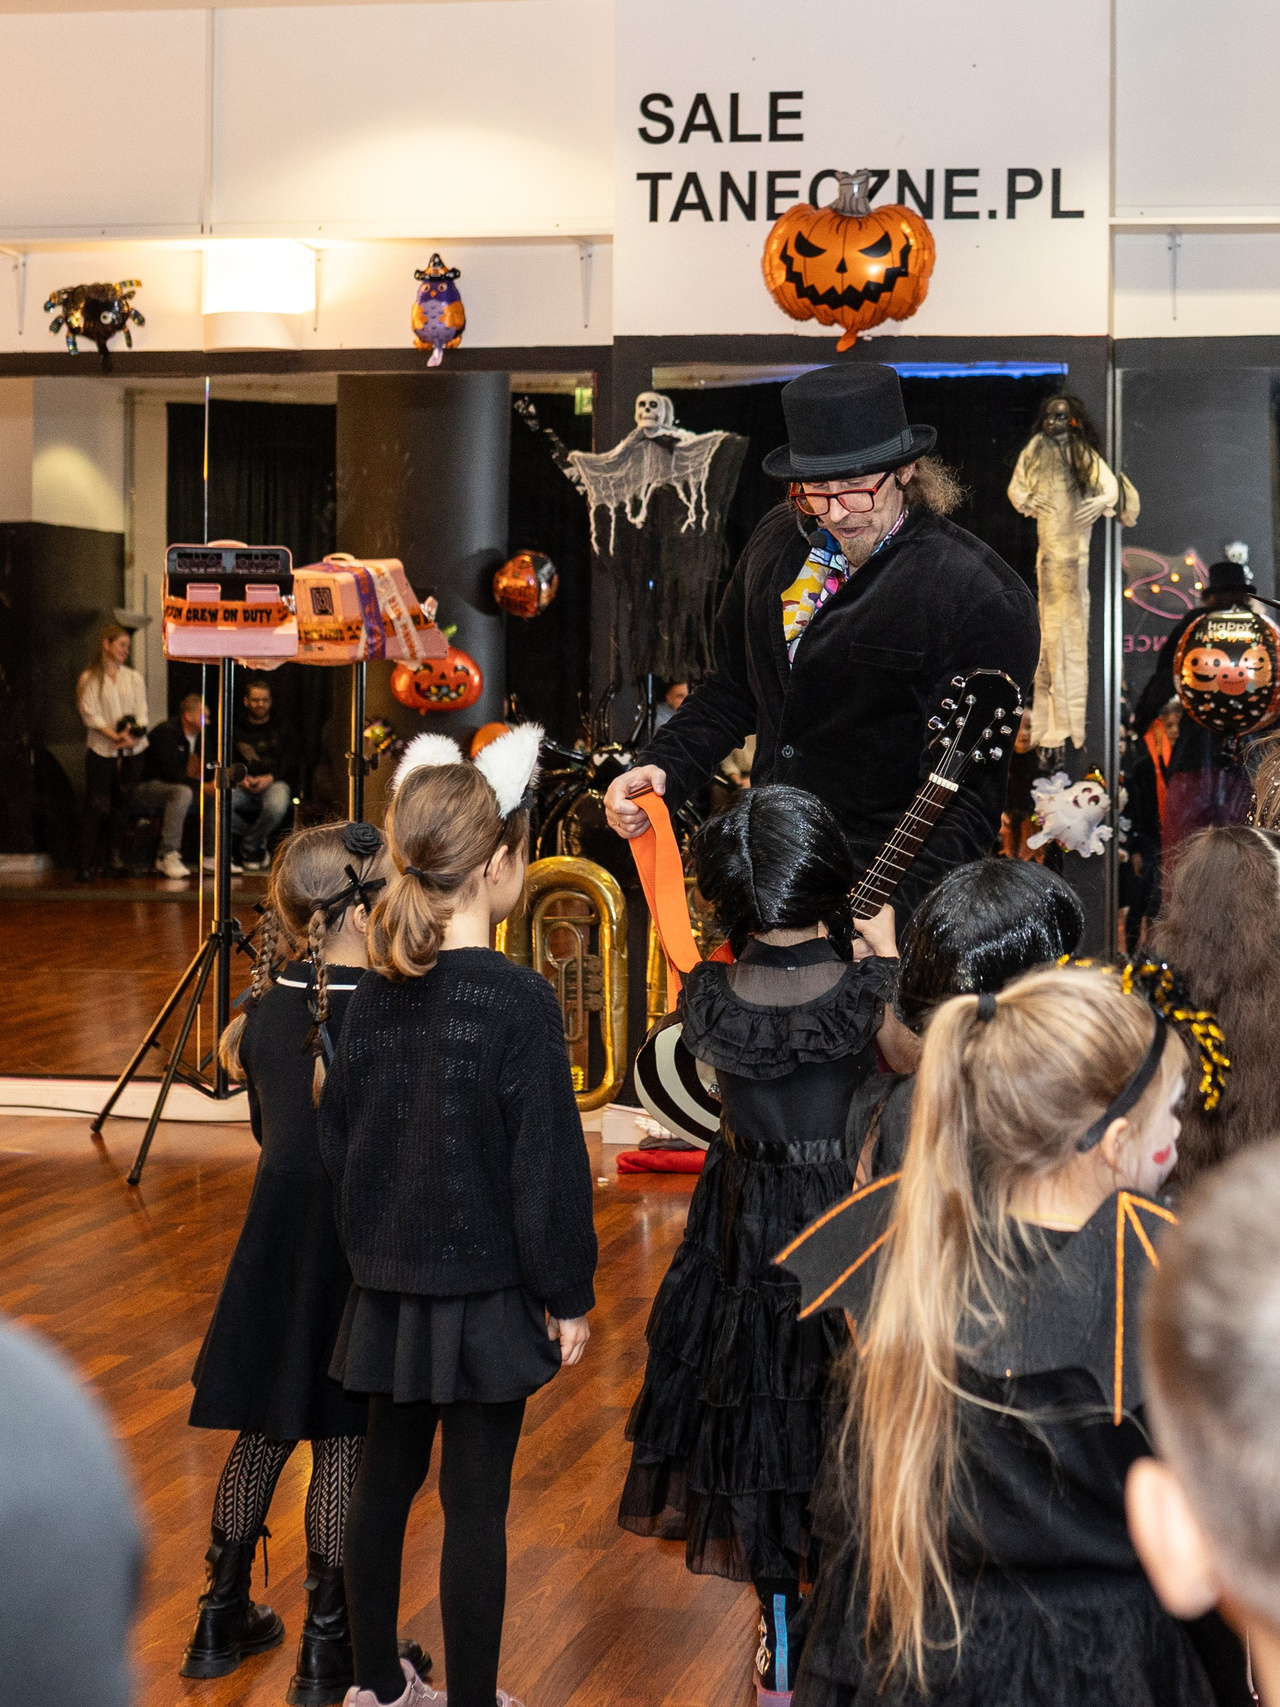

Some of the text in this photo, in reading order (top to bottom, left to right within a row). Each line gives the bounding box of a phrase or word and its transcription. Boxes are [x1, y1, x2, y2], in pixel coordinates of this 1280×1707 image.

[638, 91, 804, 144] SALE
[186, 608, 219, 622] CREW
[223, 608, 239, 622] ON
[243, 608, 272, 623] DUTY
